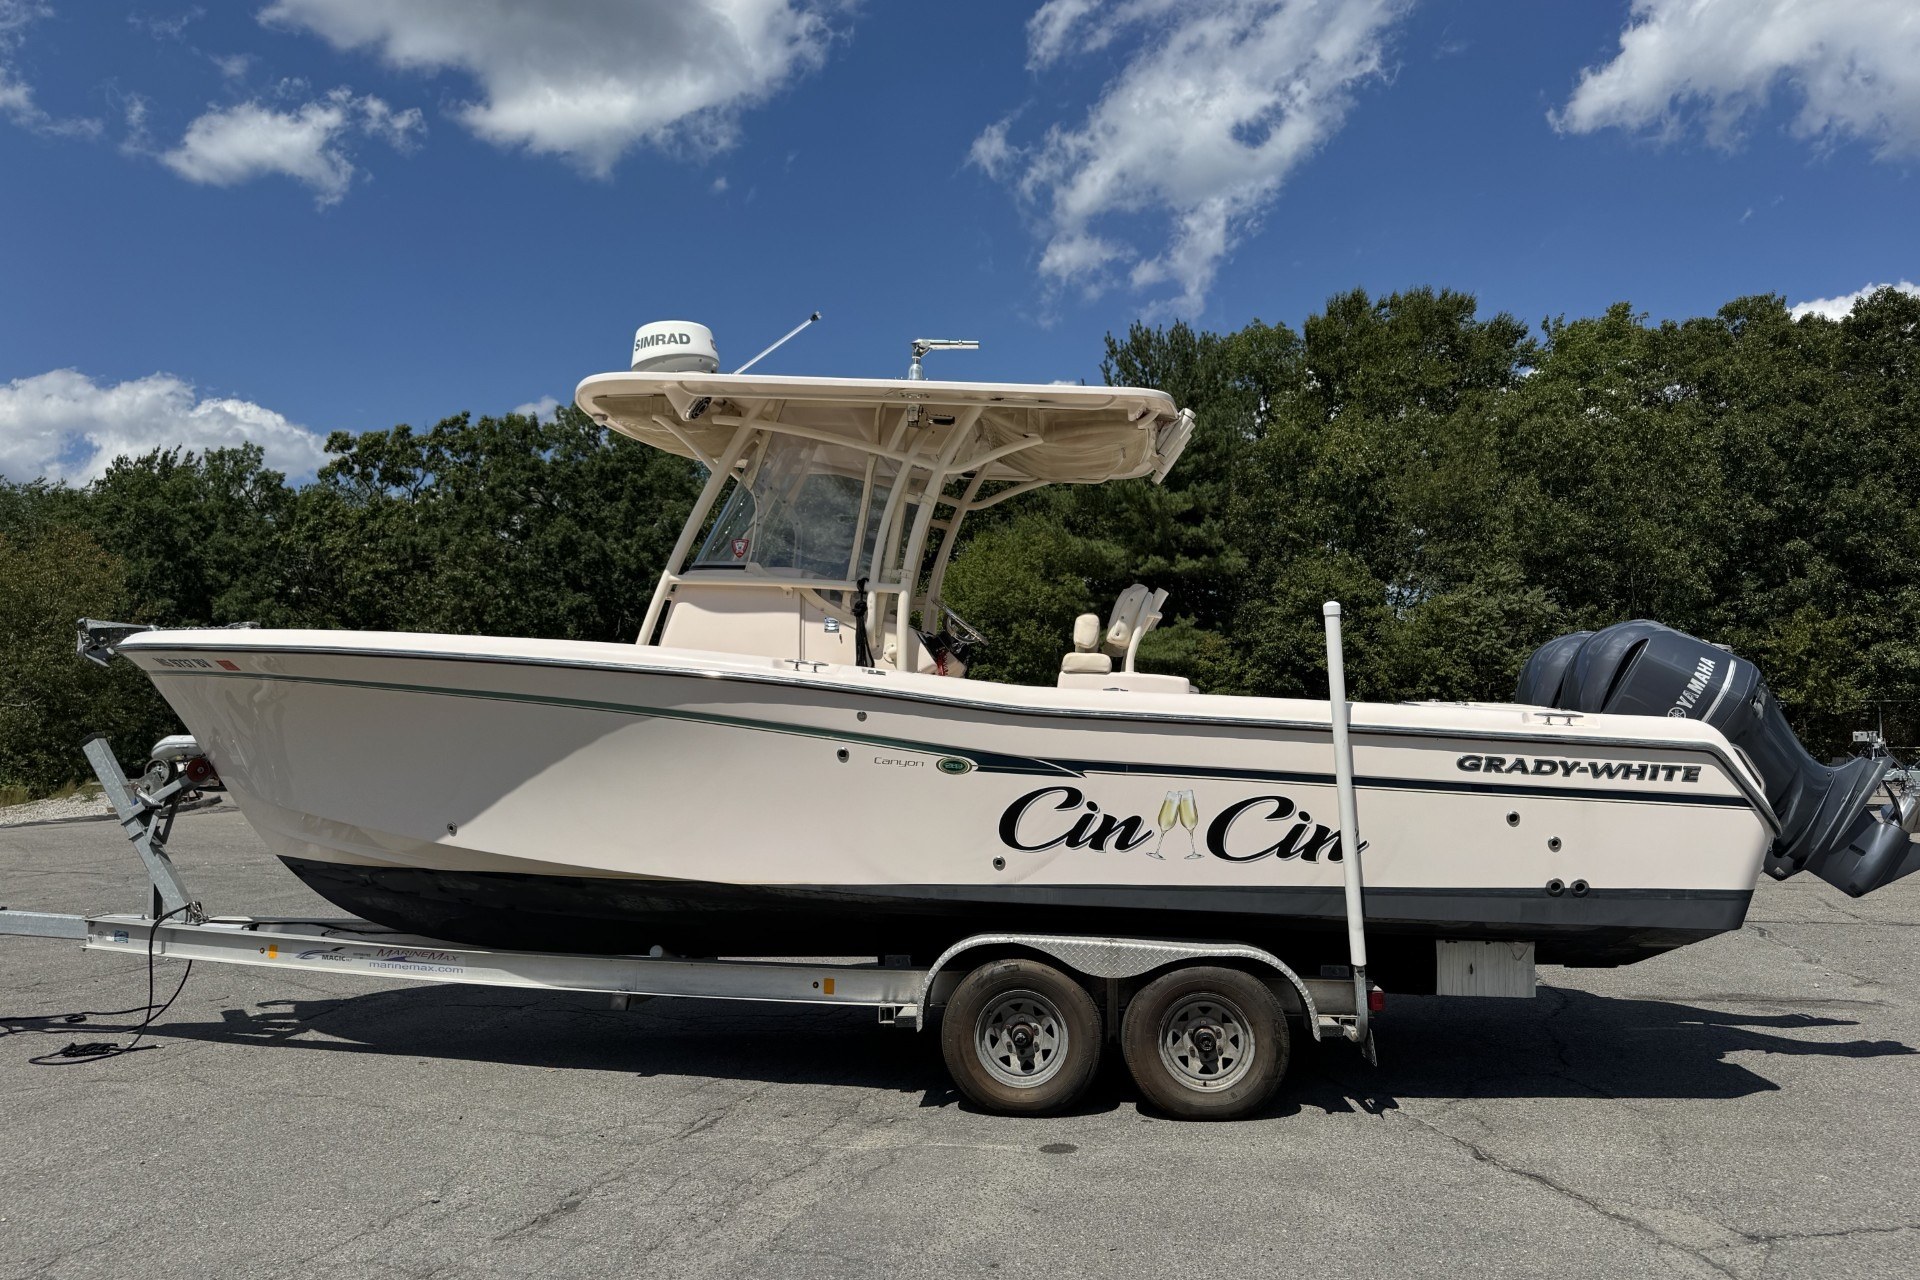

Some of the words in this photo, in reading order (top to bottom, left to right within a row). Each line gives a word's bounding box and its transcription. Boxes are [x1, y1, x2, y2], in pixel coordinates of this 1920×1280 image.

[635, 333, 691, 352] SIMRAD
[1675, 656, 1716, 709] YAMAHA
[873, 757, 925, 768] Canyon
[1456, 754, 1702, 783] GRADY-WHITE
[999, 785, 1154, 854] Cin
[1206, 794, 1370, 865] Cin
[368, 960, 465, 975] marinemax.com
